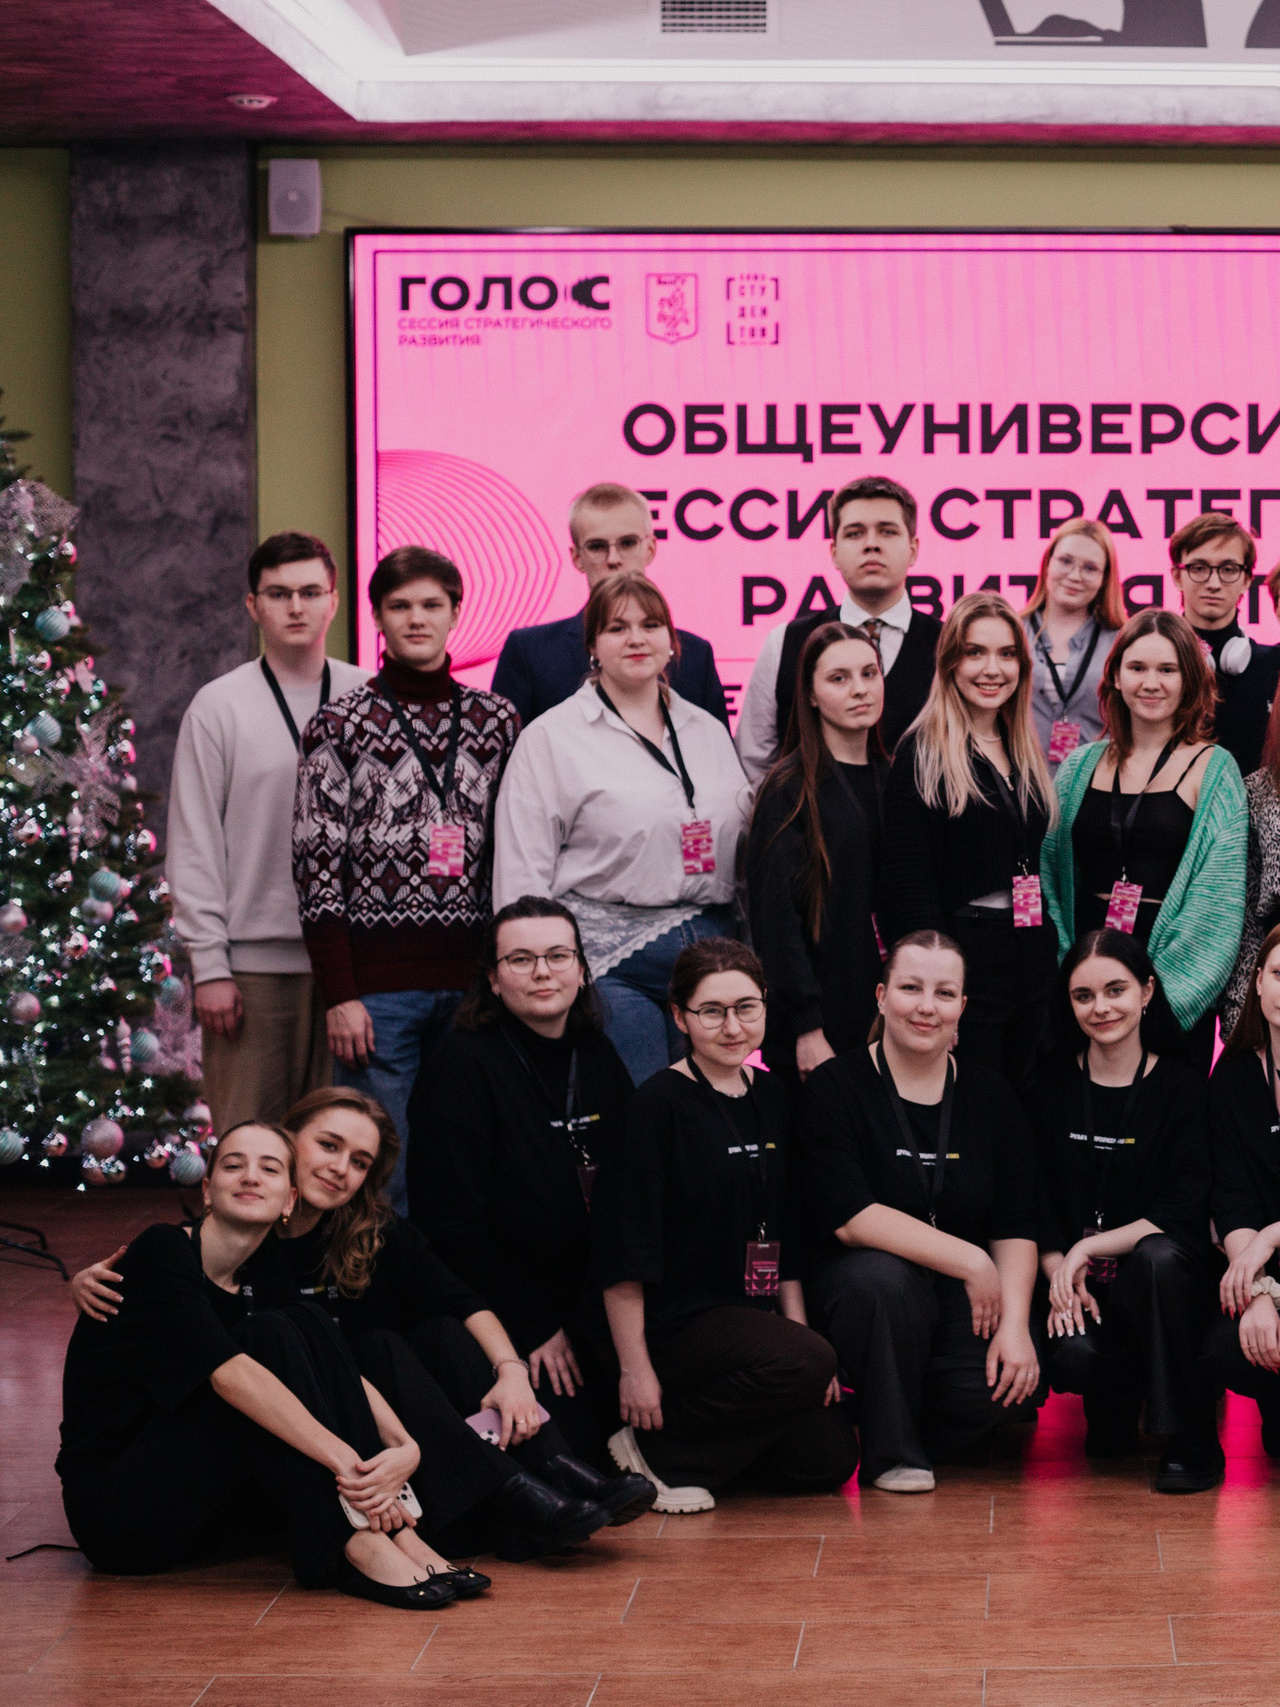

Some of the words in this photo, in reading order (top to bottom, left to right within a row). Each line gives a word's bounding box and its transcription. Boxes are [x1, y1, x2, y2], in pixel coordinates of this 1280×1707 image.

[398, 317, 460, 331] СЕССИЯ
[463, 317, 612, 331] СТРАТЕГИЧЕСКОГО
[398, 335, 482, 347] РАЗВИТИЯ
[637, 488, 835, 541] ССИ
